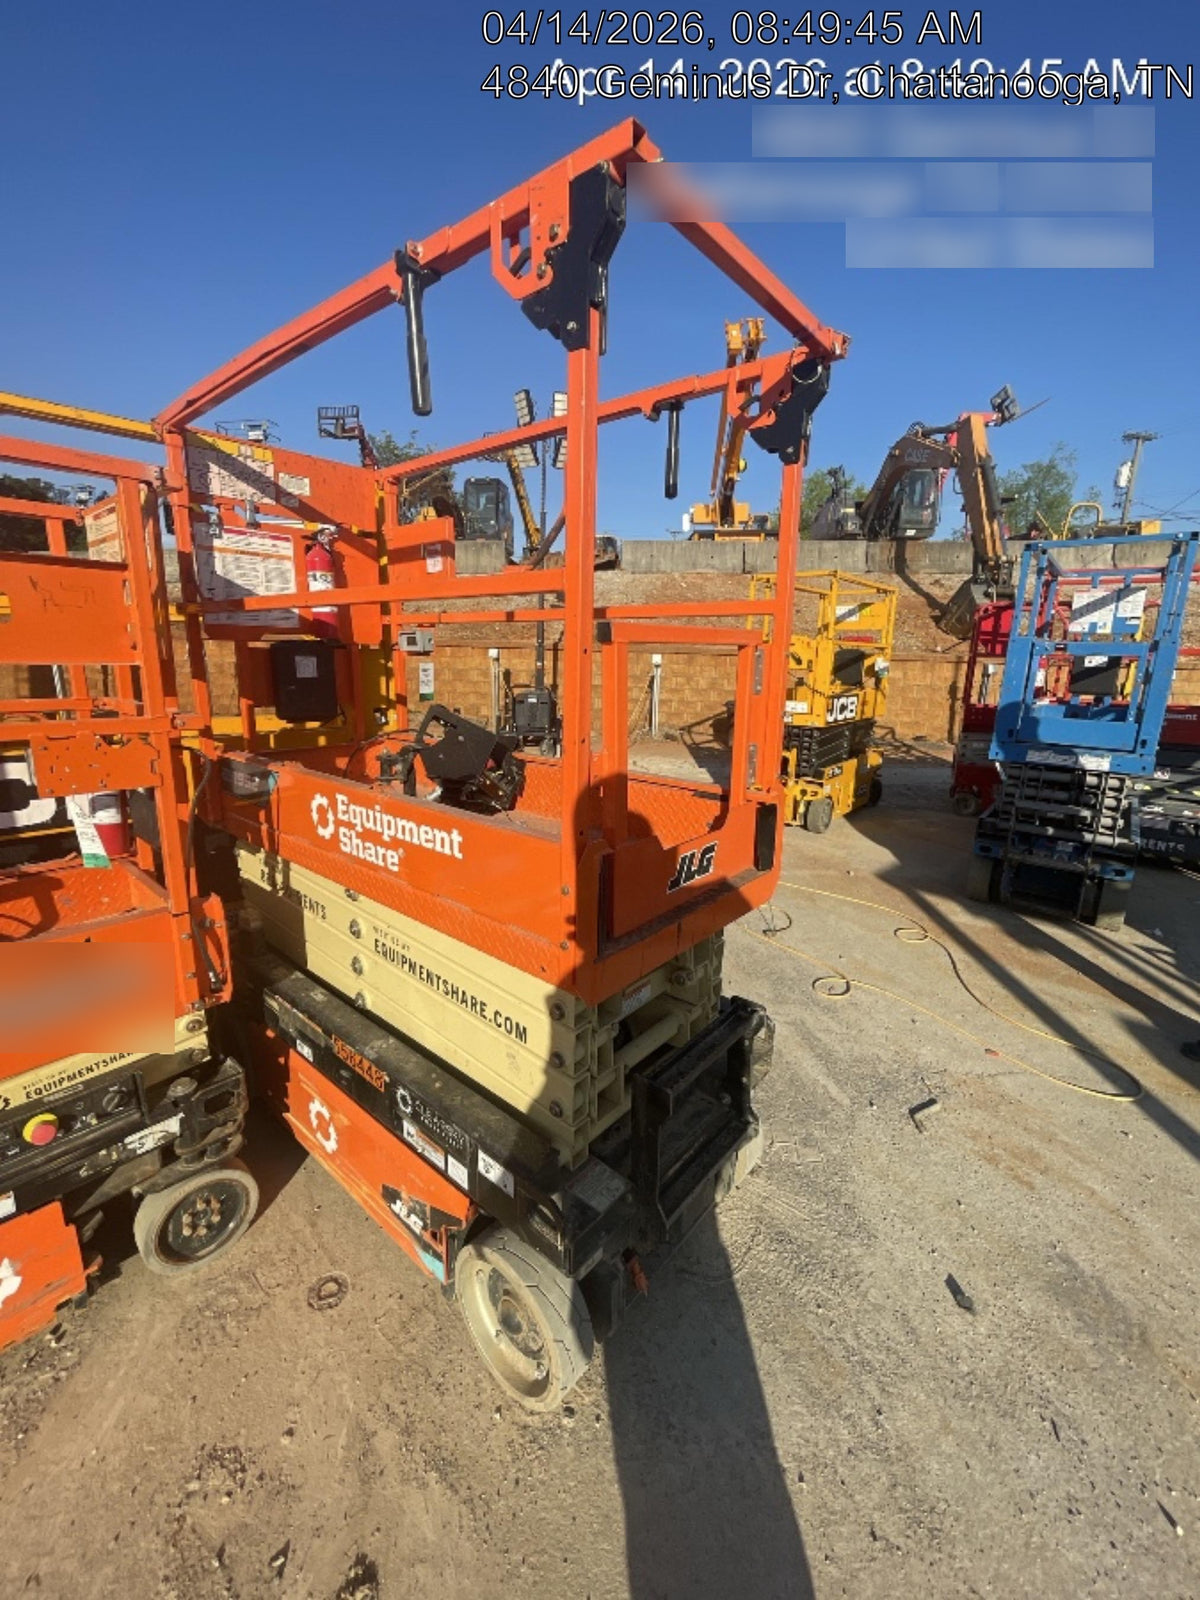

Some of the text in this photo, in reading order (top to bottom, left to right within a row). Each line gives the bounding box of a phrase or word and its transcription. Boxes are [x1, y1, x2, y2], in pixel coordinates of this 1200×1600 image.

[826, 696, 858, 723] JCB
[335, 793, 463, 859] Equipment
[337, 826, 400, 872] Share
[667, 841, 718, 894] JLG
[374, 937, 529, 1045] EQUIPMENTSHARE.COM
